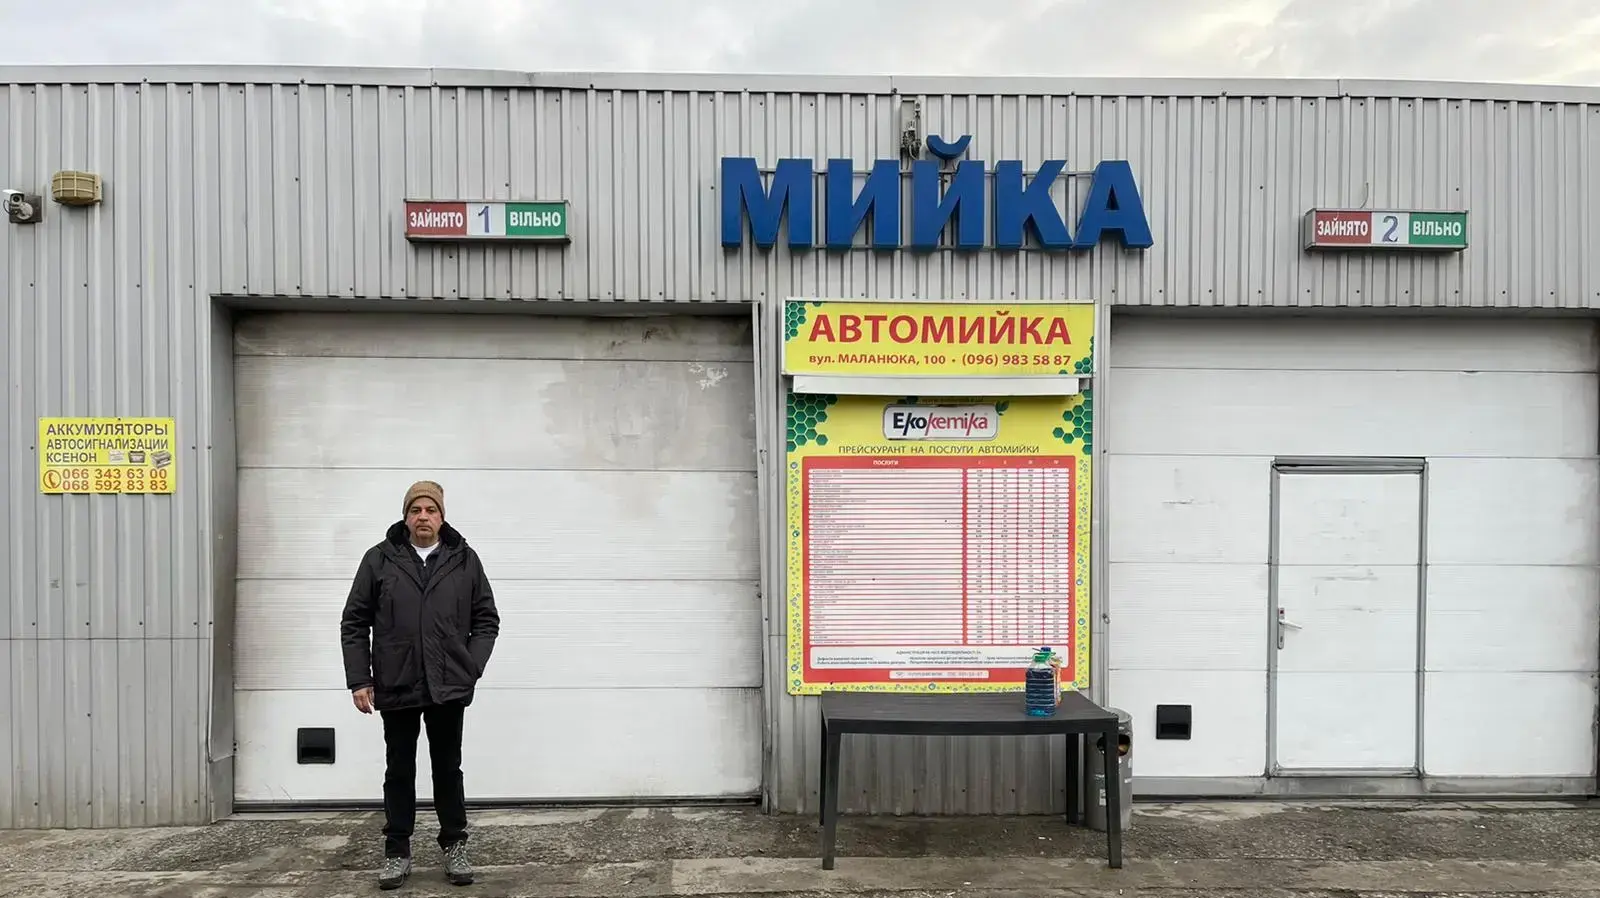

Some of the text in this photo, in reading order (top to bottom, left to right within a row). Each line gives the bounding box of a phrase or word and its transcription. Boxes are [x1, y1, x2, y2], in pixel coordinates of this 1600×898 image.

[721, 134, 1154, 249] МИЙКА
[410, 205, 562, 234] ЗАЙНЯТО 1 ВІЛЬНО
[1317, 215, 1462, 243] ЗАЙНЯТО 2 ВІЛЬНО
[808, 310, 1072, 345] АВТОМИЙКА
[809, 354, 1071, 367] вул. МАЛАНЮКА, 100 (096) 983 58 87
[46, 423, 168, 436] АККУМУЛЯТОРЫ
[46, 438, 169, 451] АВТОСИГНАЛИЗАЦИИ
[838, 444, 1040, 455] ПРЕЙСКУРАНТ НА ПОСЛУГИ АВТОМИЙКИ
[46, 452, 97, 463] КСЕНОН
[62, 468, 167, 479] 066 343 63 00
[62, 480, 168, 491] 068 592 83 83
